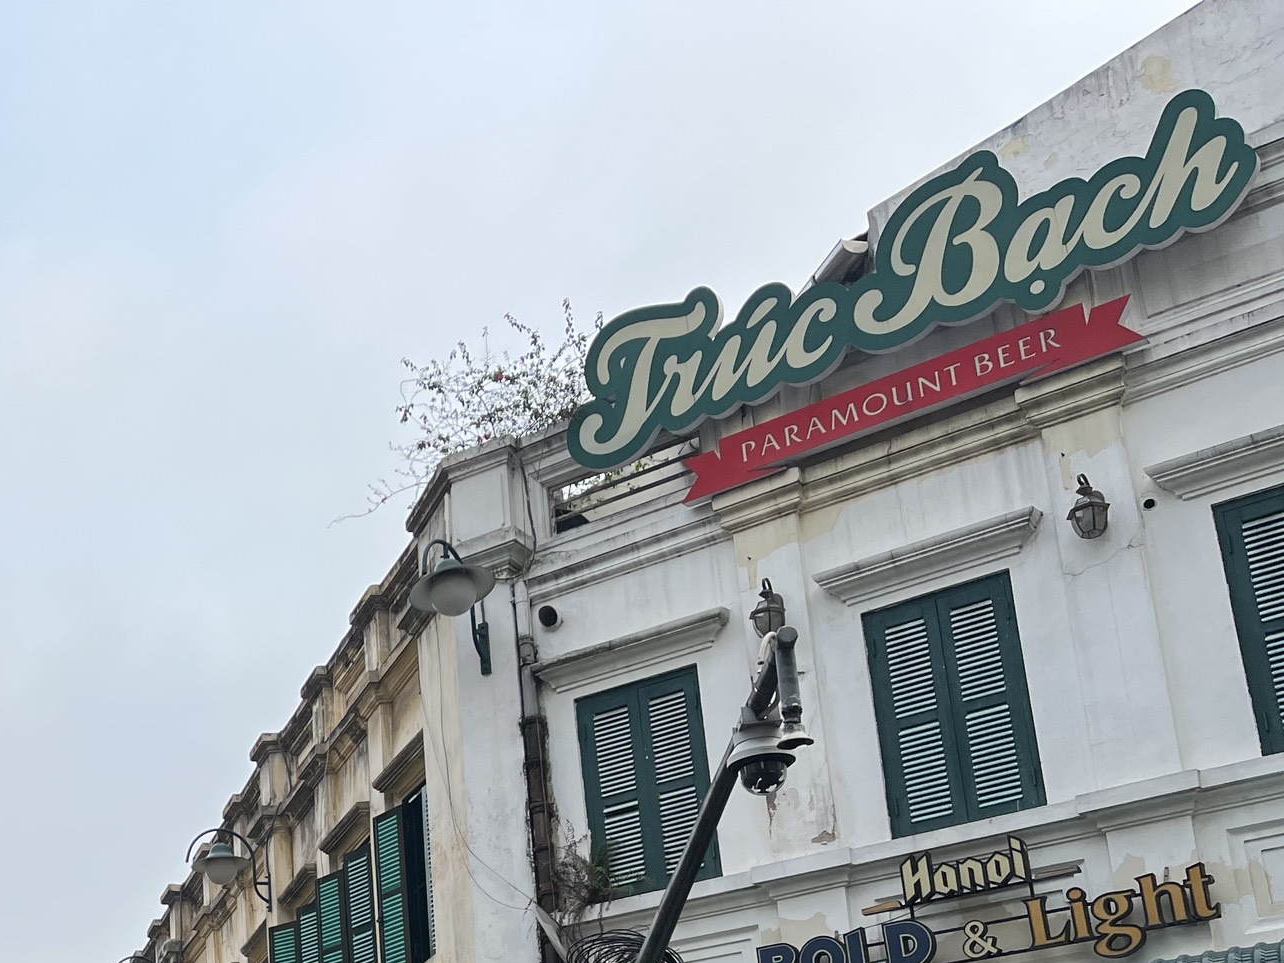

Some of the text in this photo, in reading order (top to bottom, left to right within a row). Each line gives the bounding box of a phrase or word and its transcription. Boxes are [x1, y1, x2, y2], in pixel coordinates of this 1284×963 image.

[579, 106, 1238, 456] Trúc Bạch
[739, 326, 1062, 464] PARAMOUNT BEER
[900, 834, 1031, 906] Hanoi
[963, 919, 1001, 960] &
[1023, 861, 1222, 959] Light
